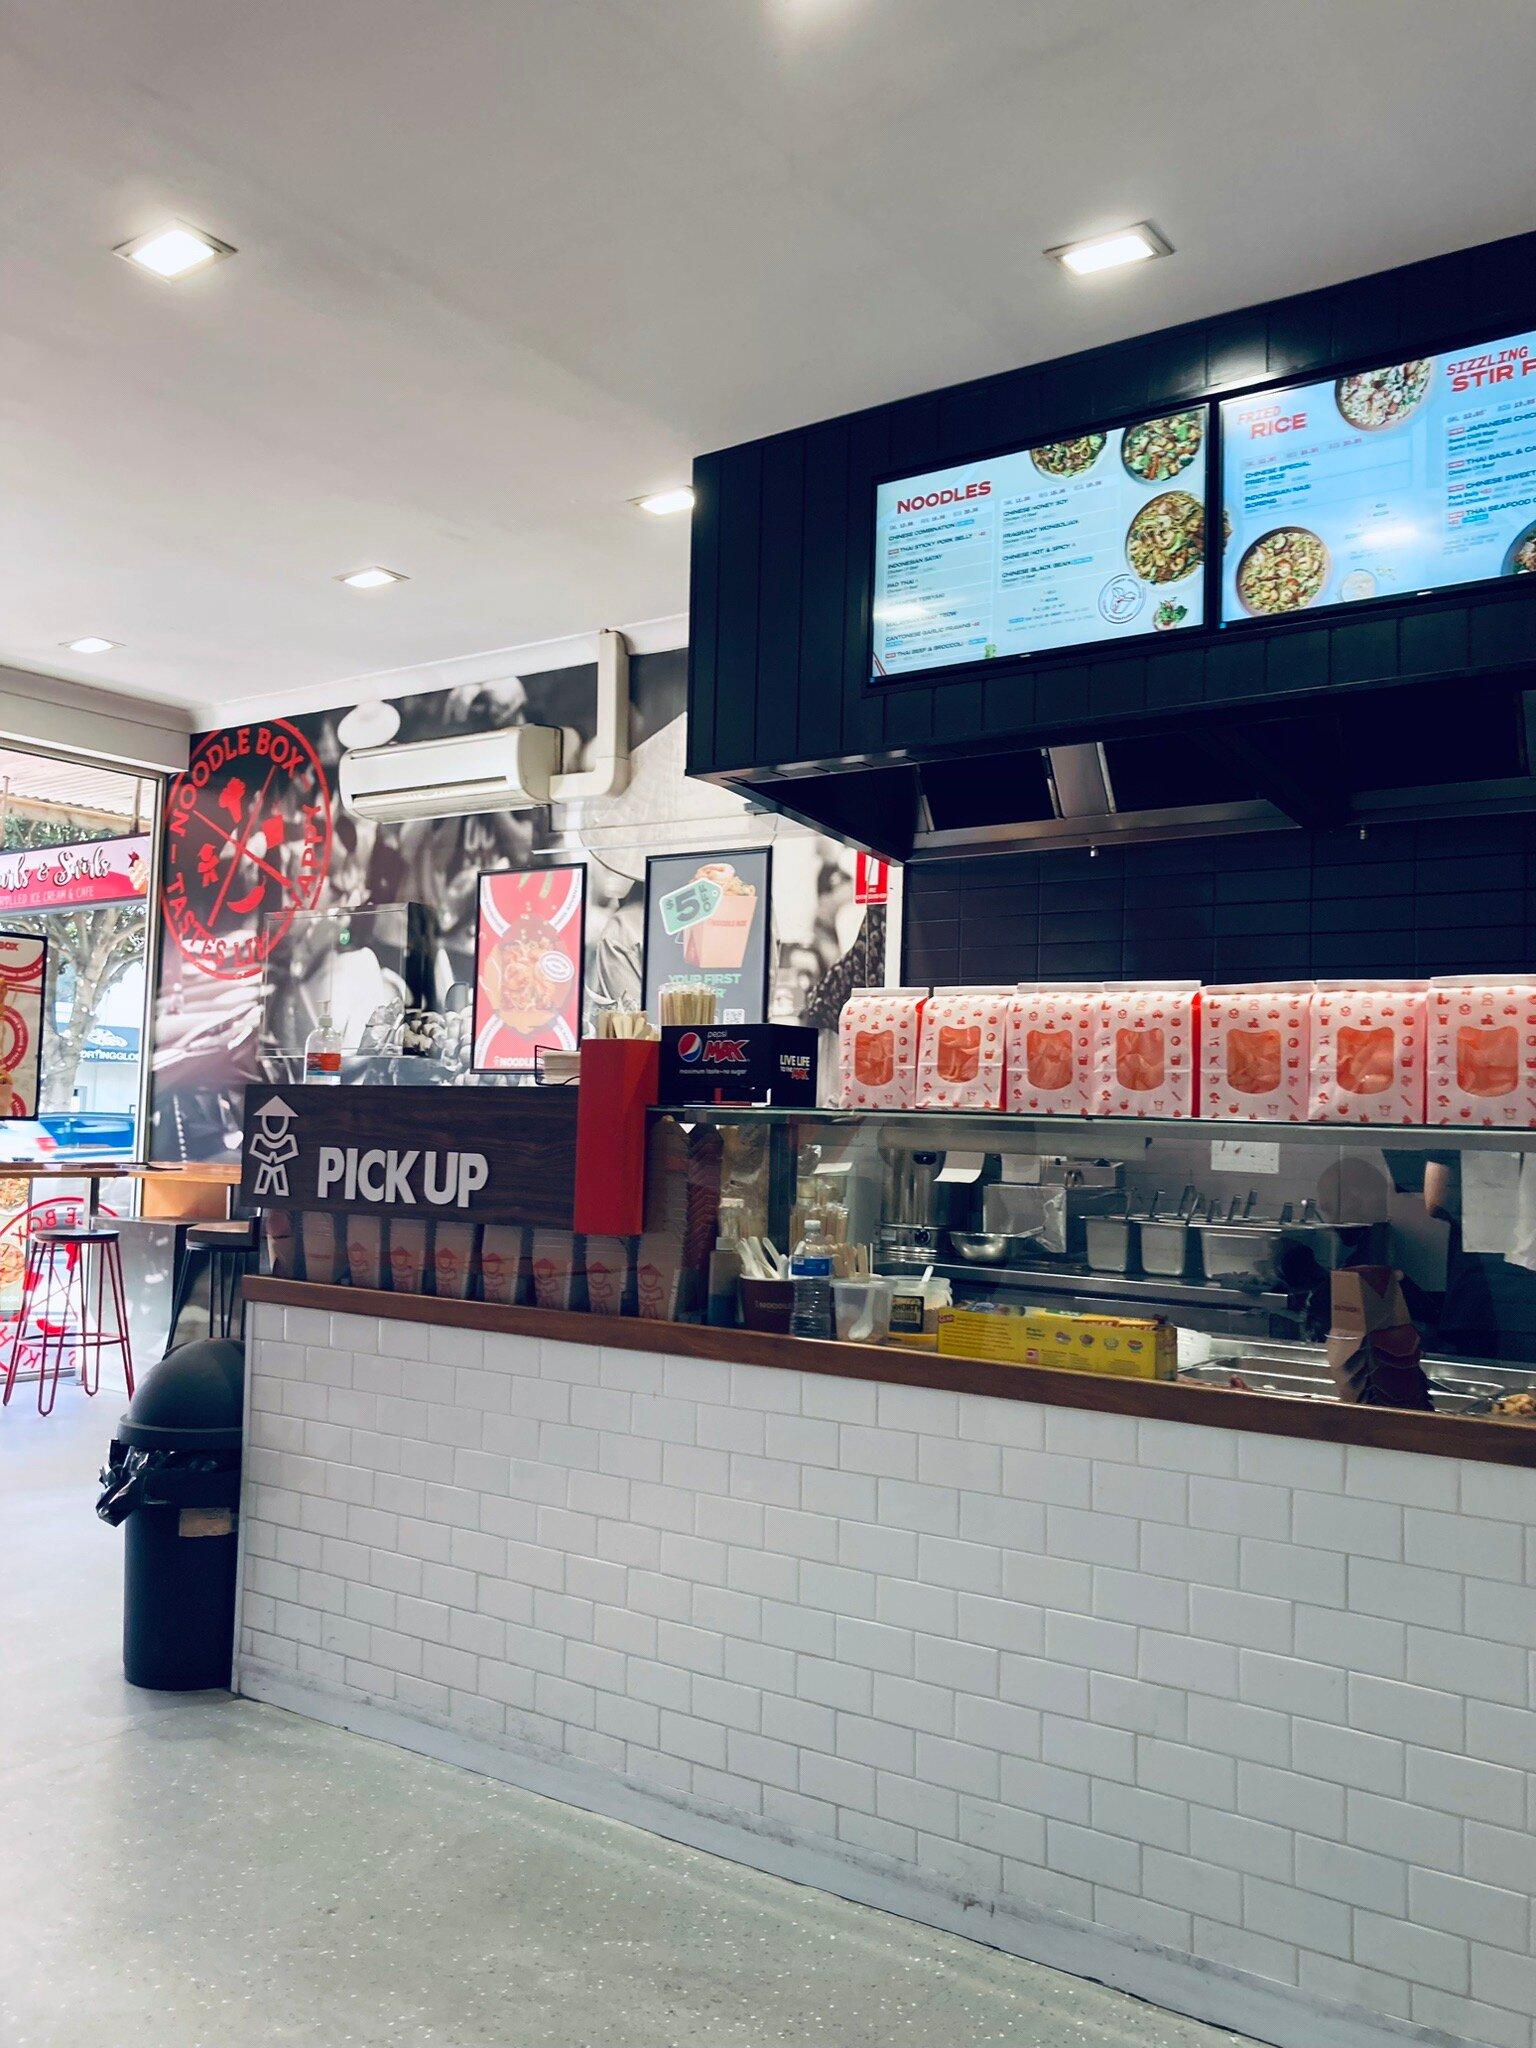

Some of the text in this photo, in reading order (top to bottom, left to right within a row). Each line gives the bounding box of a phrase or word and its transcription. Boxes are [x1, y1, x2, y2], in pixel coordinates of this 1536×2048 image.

[1446, 346, 1528, 376] SIZZLING
[1452, 364, 1513, 392] STIR
[1238, 406, 1281, 424] FRIED
[1251, 412, 1308, 440] RICE
[1466, 477, 1503, 489] CHINESE
[896, 481, 991, 514] NOODLES
[1488, 499, 1531, 511] SEAFOOD
[168, 727, 306, 838] NOODLE BOX
[36, 861, 51, 883] &
[668, 972, 743, 984] YOUR FIRST
[707, 1029, 728, 1038] pepsi
[702, 1039, 750, 1063] MAX
[780, 1054, 811, 1067] LIVE LIFE
[316, 1146, 490, 1208] PICK UP
